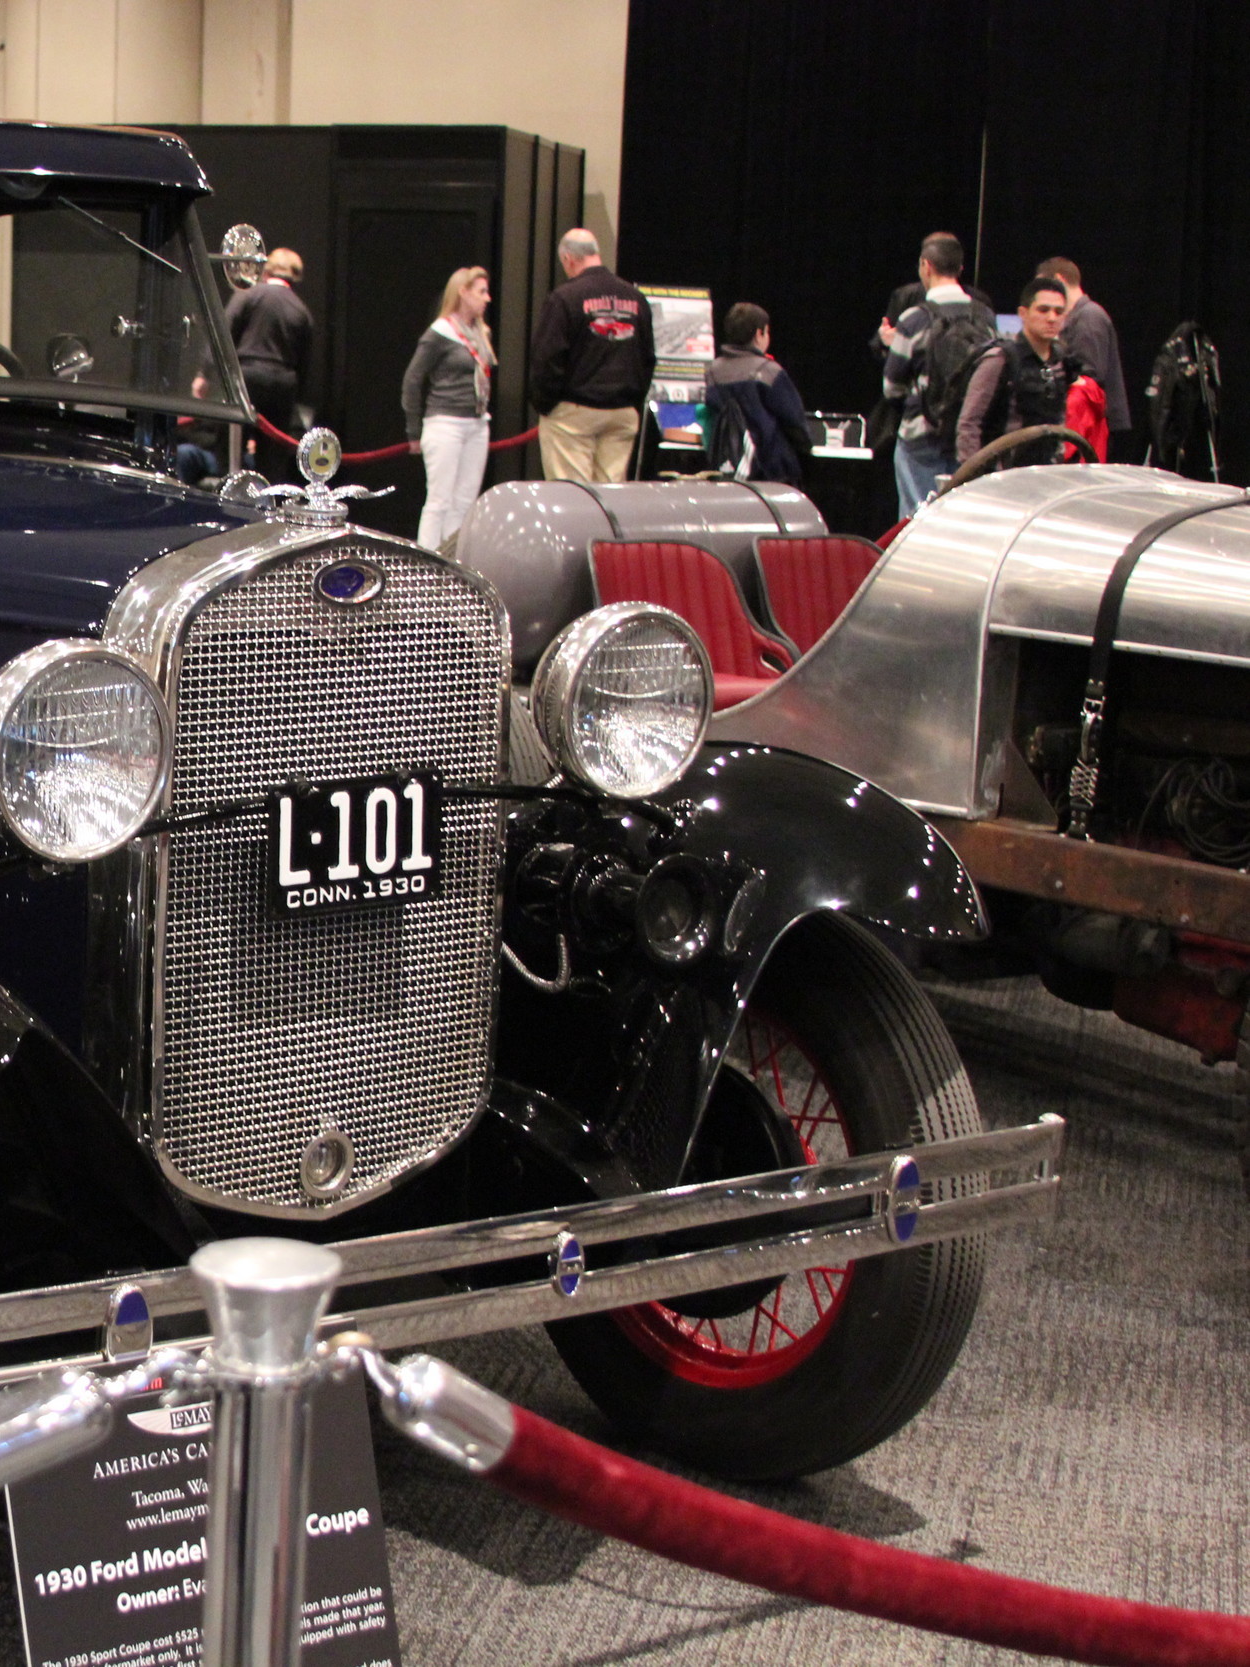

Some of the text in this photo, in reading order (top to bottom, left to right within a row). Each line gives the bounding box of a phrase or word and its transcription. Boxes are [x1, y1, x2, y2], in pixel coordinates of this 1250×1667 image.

[286, 875, 425, 908] CONN. 1930
[93, 1442, 213, 1479] AMERICA'S CA
[131, 1487, 185, 1508] Tacoma,
[126, 1503, 210, 1531] www.lemaym
[34, 1507, 370, 1596] 1930 Ford Model Coupe
[116, 1584, 180, 1614] Owner:
[90, 1647, 118, 1665] Sport
[119, 1640, 151, 1657] Coupe
[153, 1634, 174, 1650] cost
[175, 1627, 199, 1645] $525
[321, 1596, 341, 1609] that
[342, 1587, 368, 1604] could
[369, 1586, 382, 1598] be
[313, 1610, 340, 1627] made
[342, 1606, 361, 1620] that
[335, 1620, 357, 1636] with
[359, 1615, 386, 1632] safety
